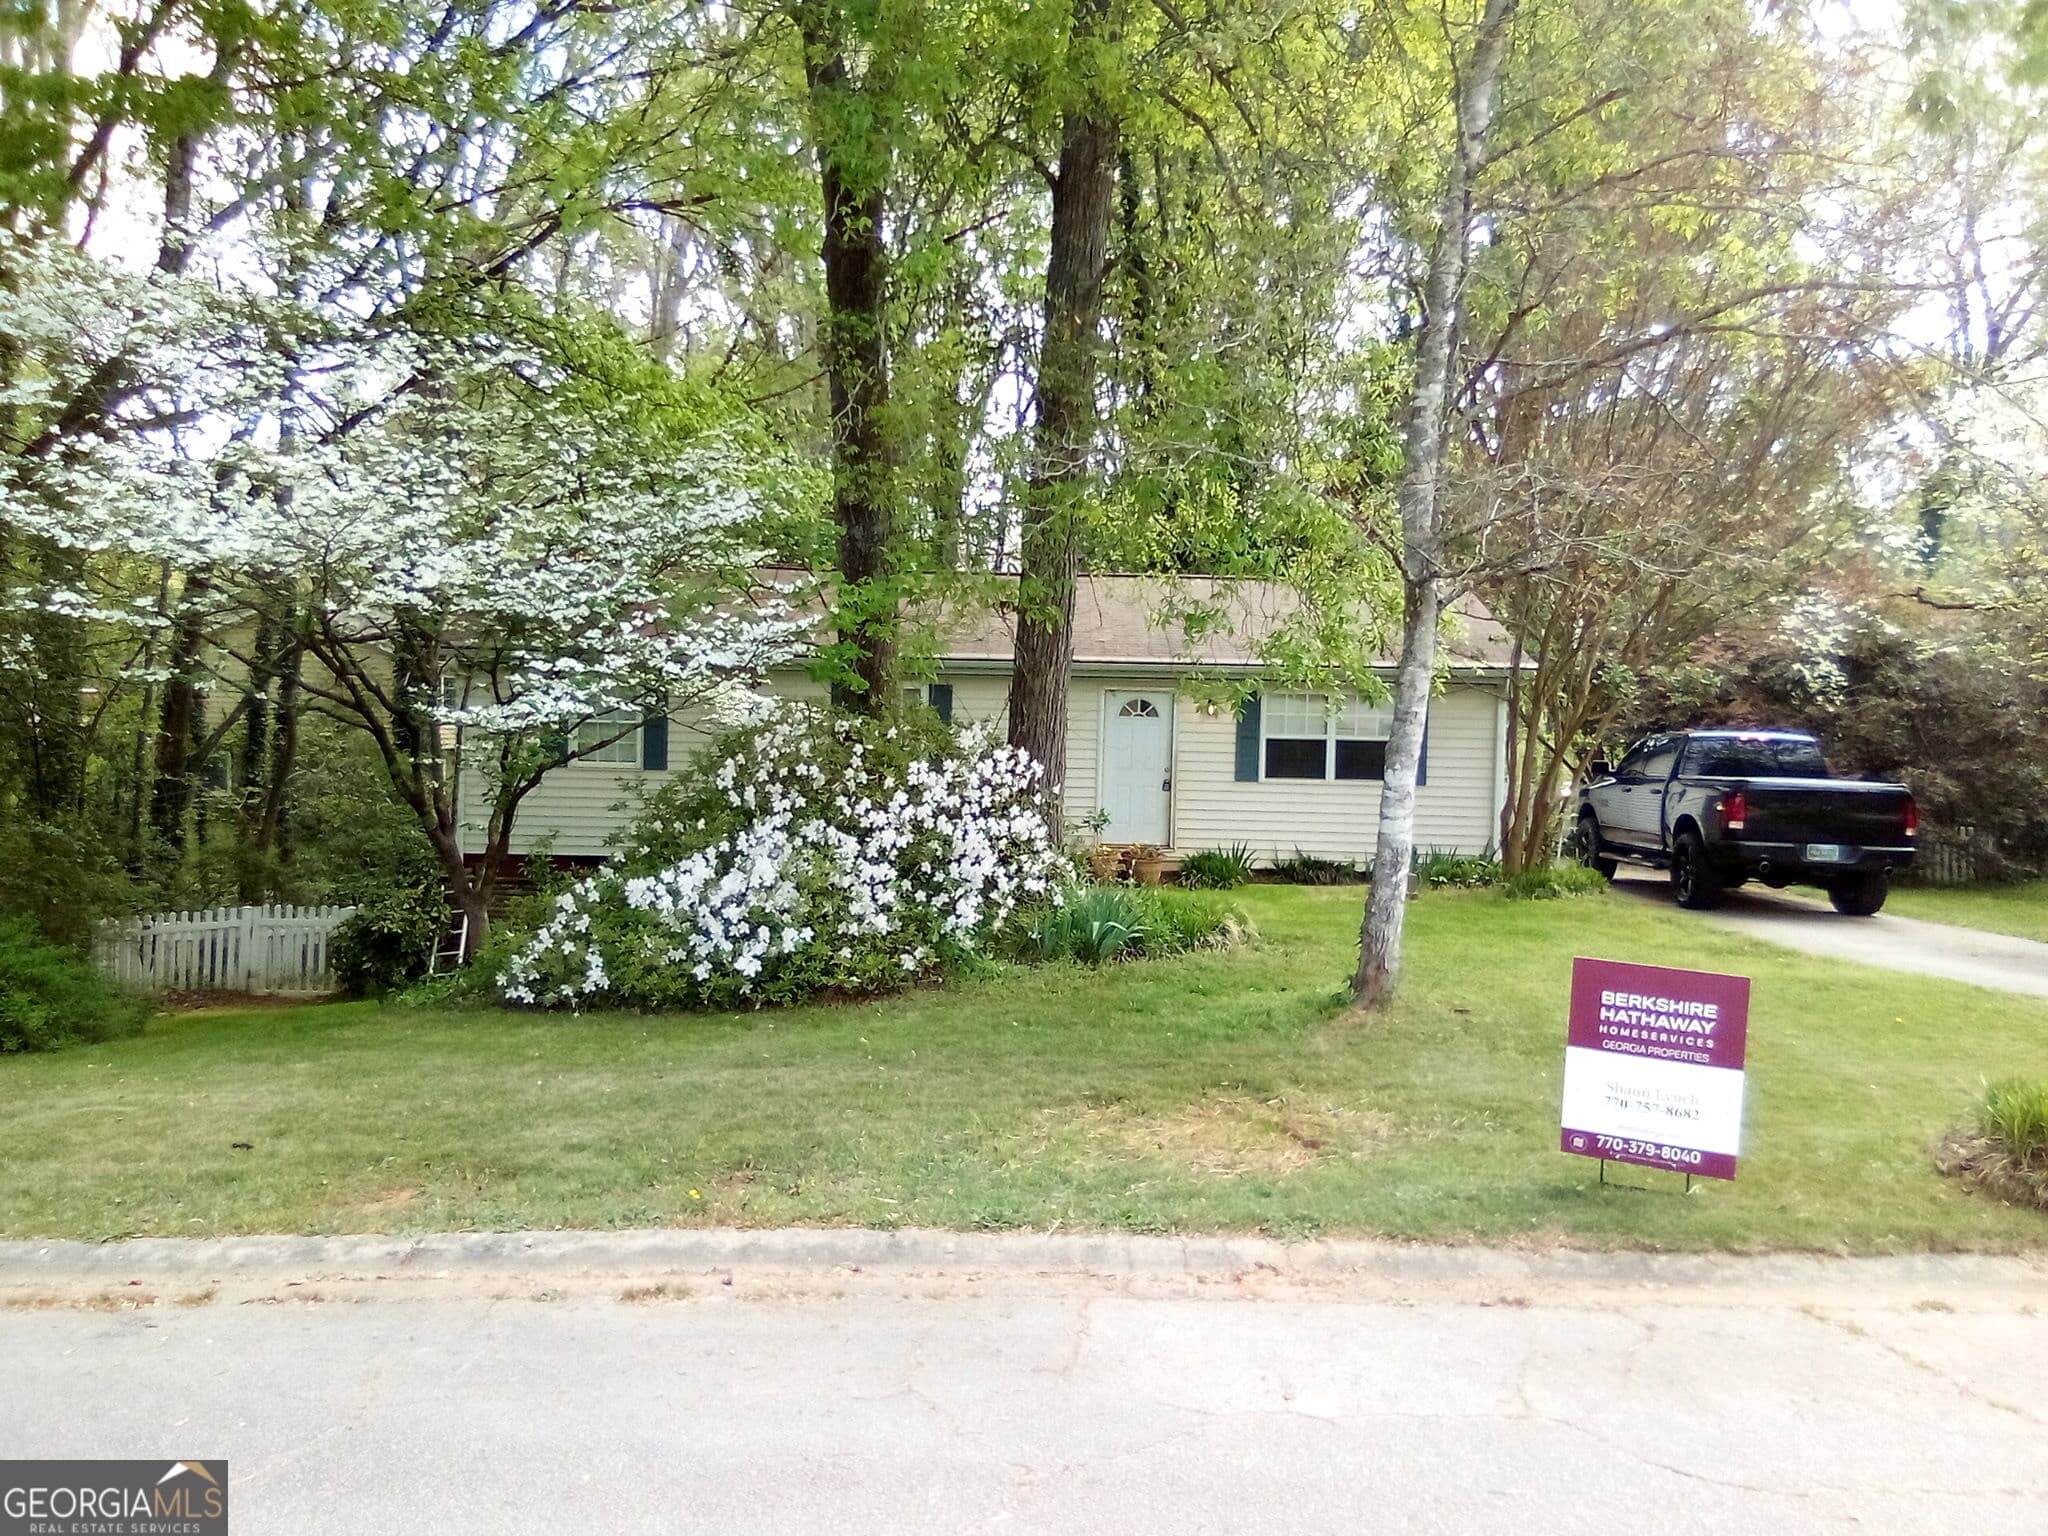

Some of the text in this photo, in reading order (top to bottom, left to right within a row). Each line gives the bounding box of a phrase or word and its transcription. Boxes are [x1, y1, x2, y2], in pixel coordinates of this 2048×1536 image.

[1601, 990, 1718, 1019] BERKSHIRE
[1599, 1006, 1716, 1035] HATHAWAY
[1599, 1024, 1714, 1048] HOMESERVICES
[1602, 1039, 1709, 1063] GEORGIA PROPERTIES
[1604, 1096, 1699, 1120] 770-757-8682
[1596, 1135, 1701, 1164] 770-379-8040
